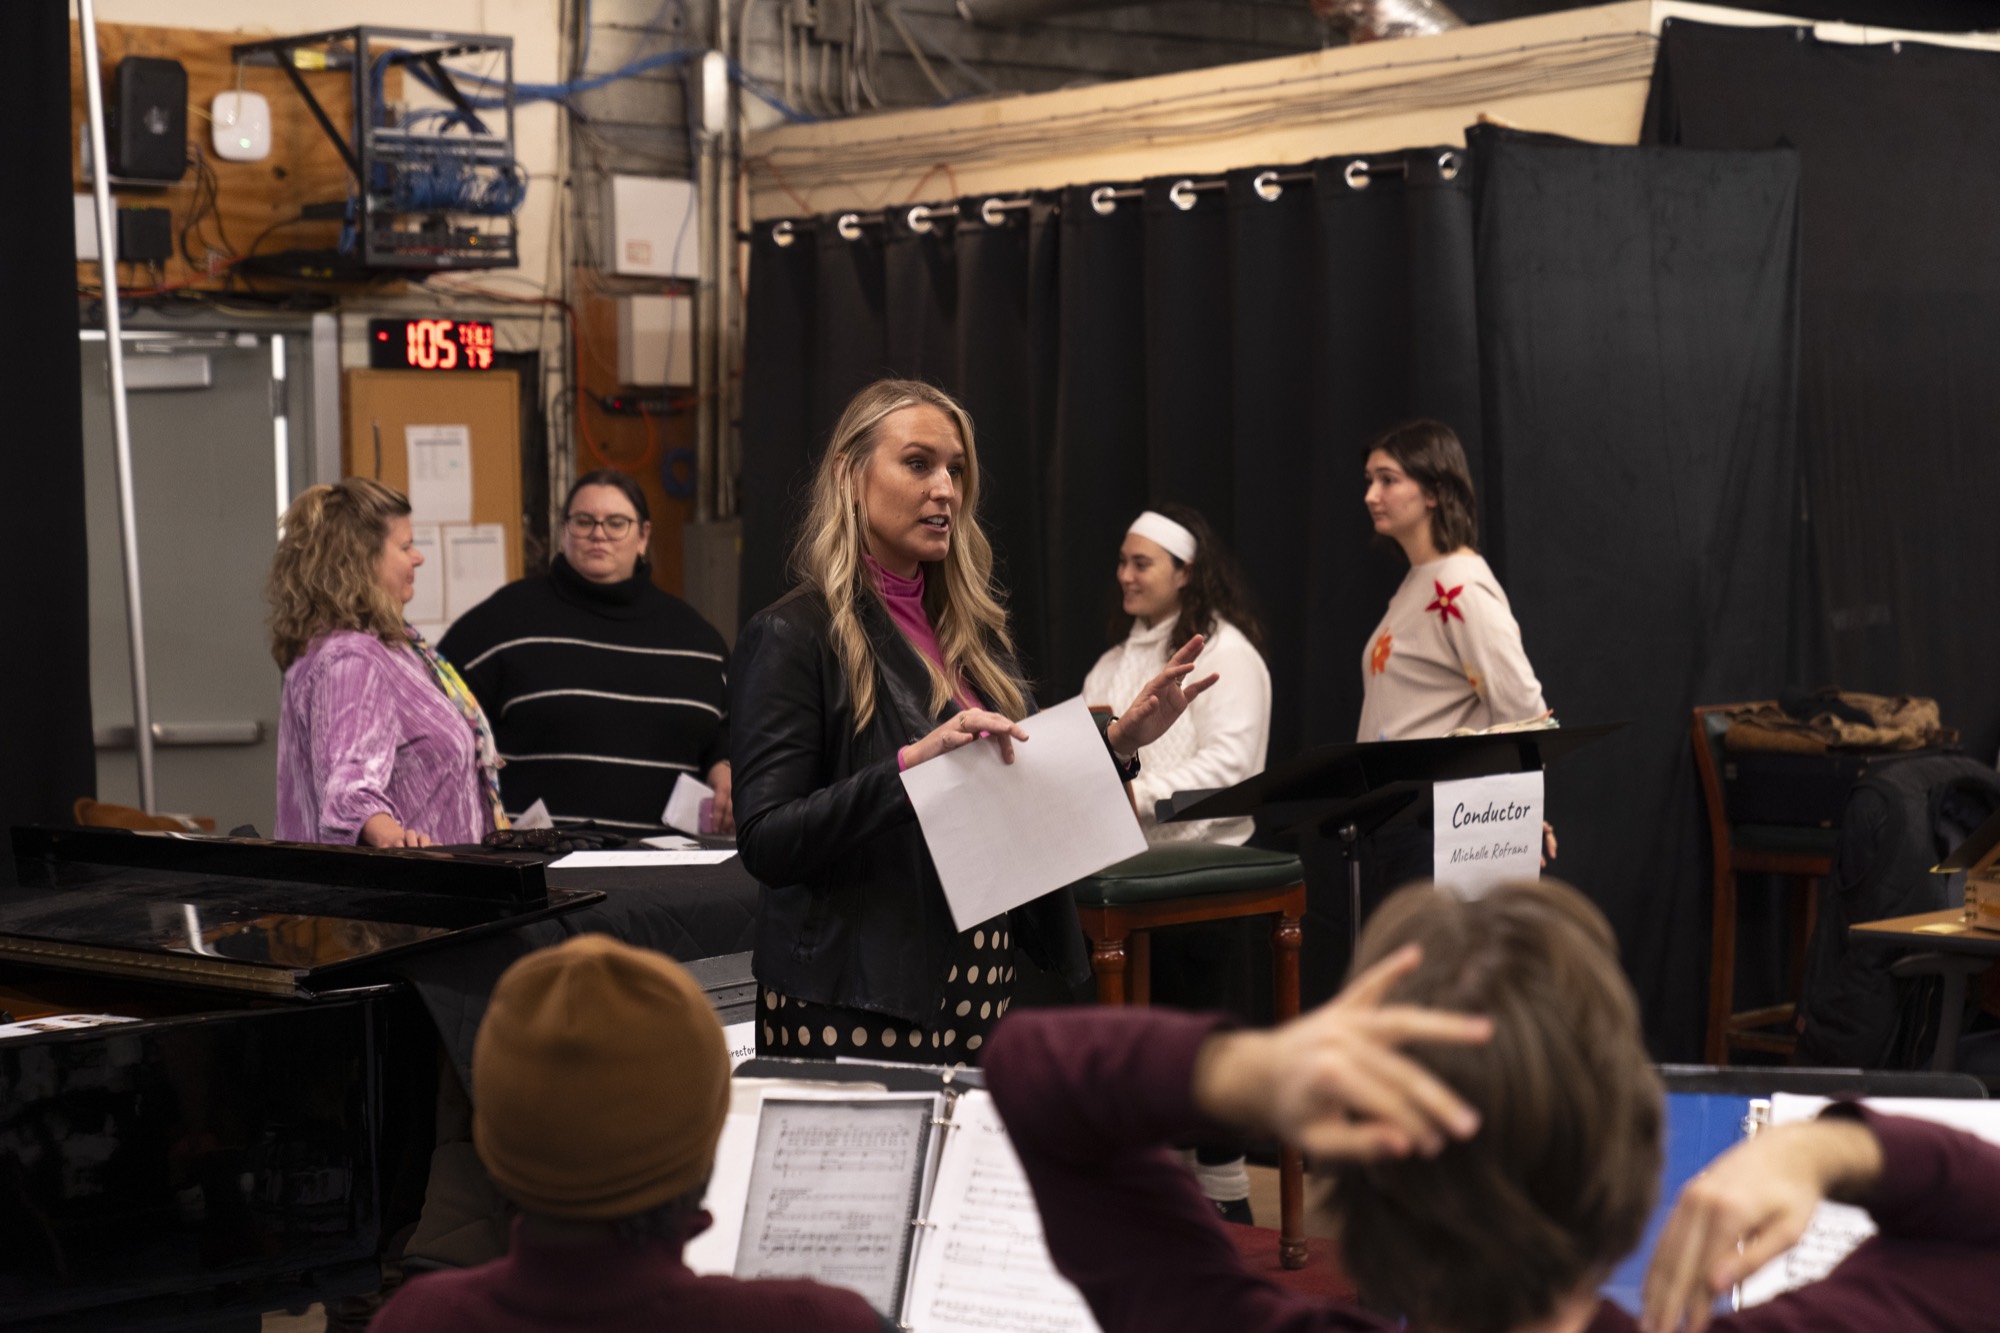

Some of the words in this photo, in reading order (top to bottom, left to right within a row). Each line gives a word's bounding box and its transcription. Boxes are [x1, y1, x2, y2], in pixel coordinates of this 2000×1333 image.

[1452, 801, 1530, 829] Conductor
[1450, 846, 1488, 863] Michelle
[1491, 842, 1528, 860] Rofrano
[728, 1044, 756, 1059] irector
